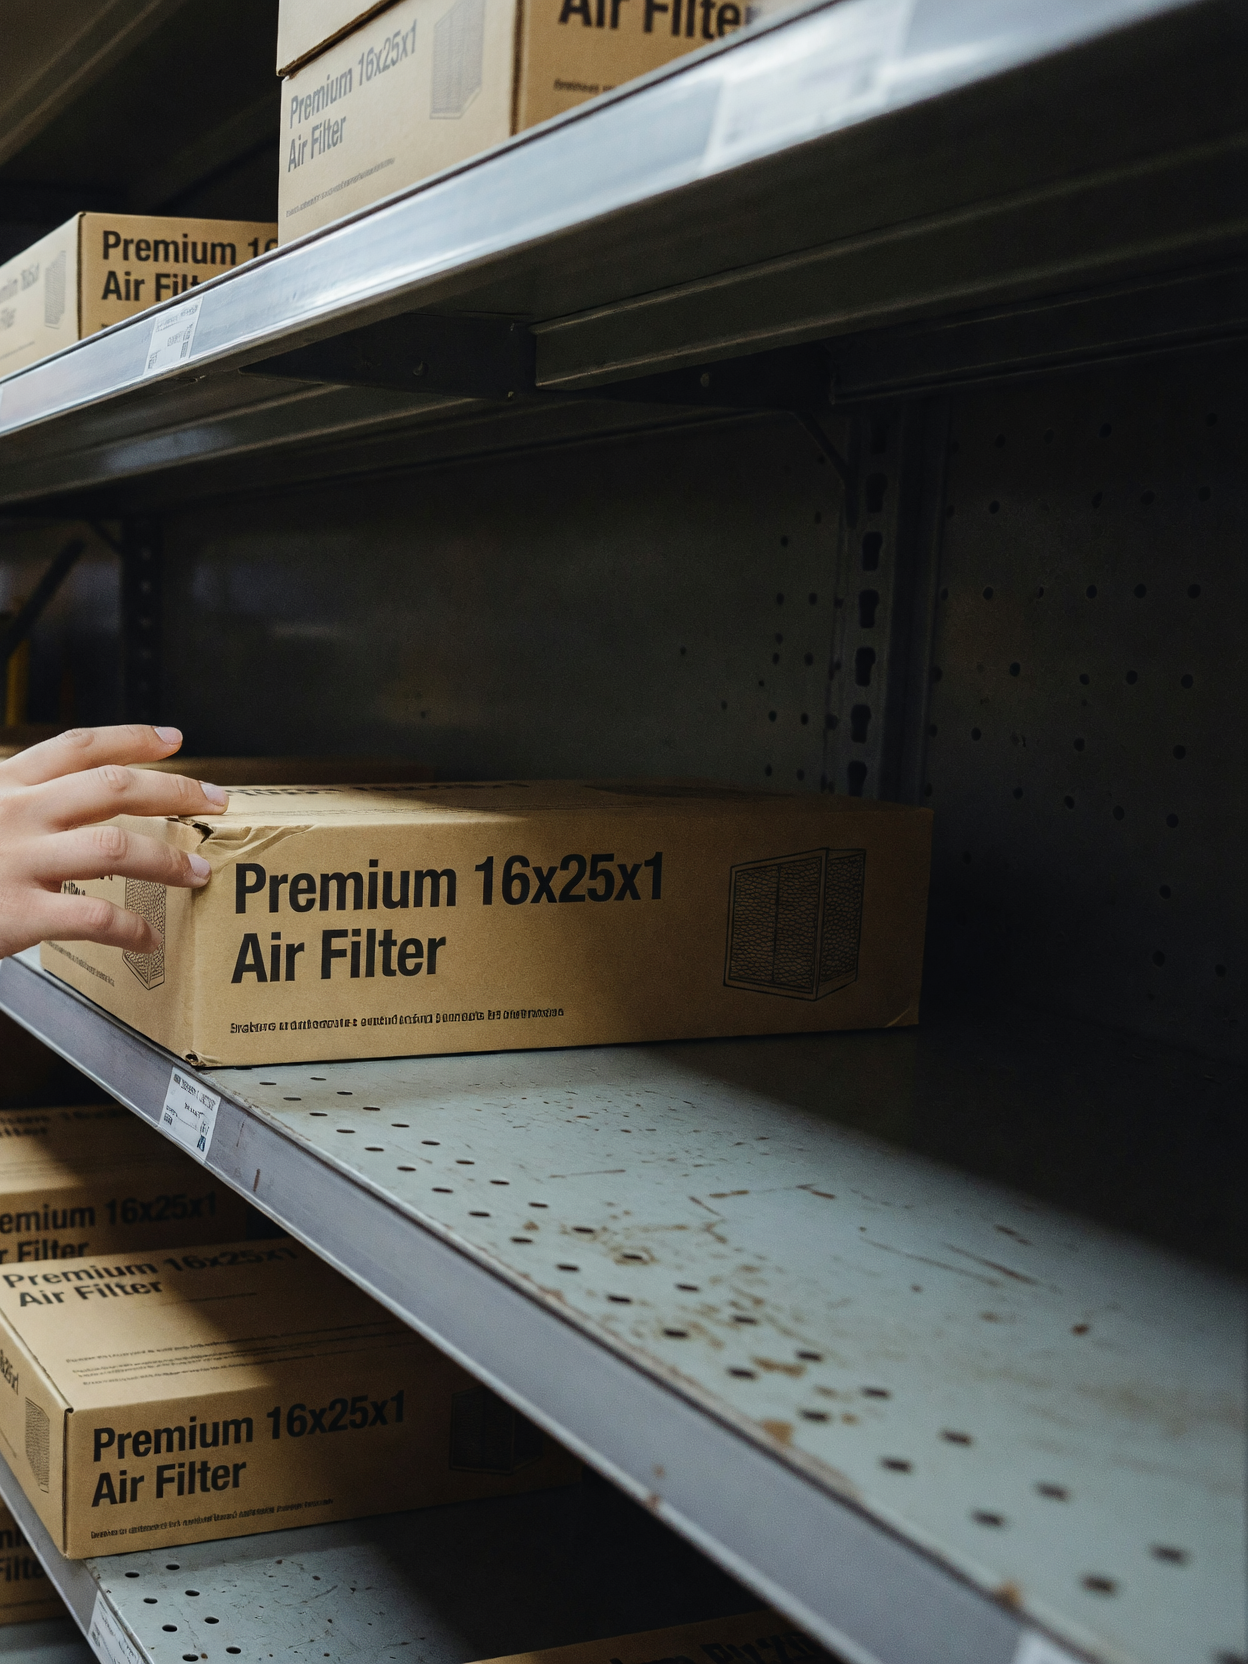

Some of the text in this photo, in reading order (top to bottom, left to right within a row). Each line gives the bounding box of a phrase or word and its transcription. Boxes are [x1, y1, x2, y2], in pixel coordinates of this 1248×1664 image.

[290, 19, 417, 129] Premium 16x25x1
[287, 116, 347, 173] Air Filter
[102, 229, 237, 266] Premium
[101, 269, 145, 301] Air
[235, 851, 665, 915] Premium 16x25x1
[230, 928, 447, 985] Air Filter
[105, 1190, 218, 1226] 16x25x1
[3, 1246, 299, 1288] Premium 16x25x1
[16, 1237, 90, 1263] Filter
[19, 1279, 164, 1307] Air Filter
[91, 1389, 405, 1462] Premium 16x25x1
[91, 1459, 247, 1507] Air Filter
